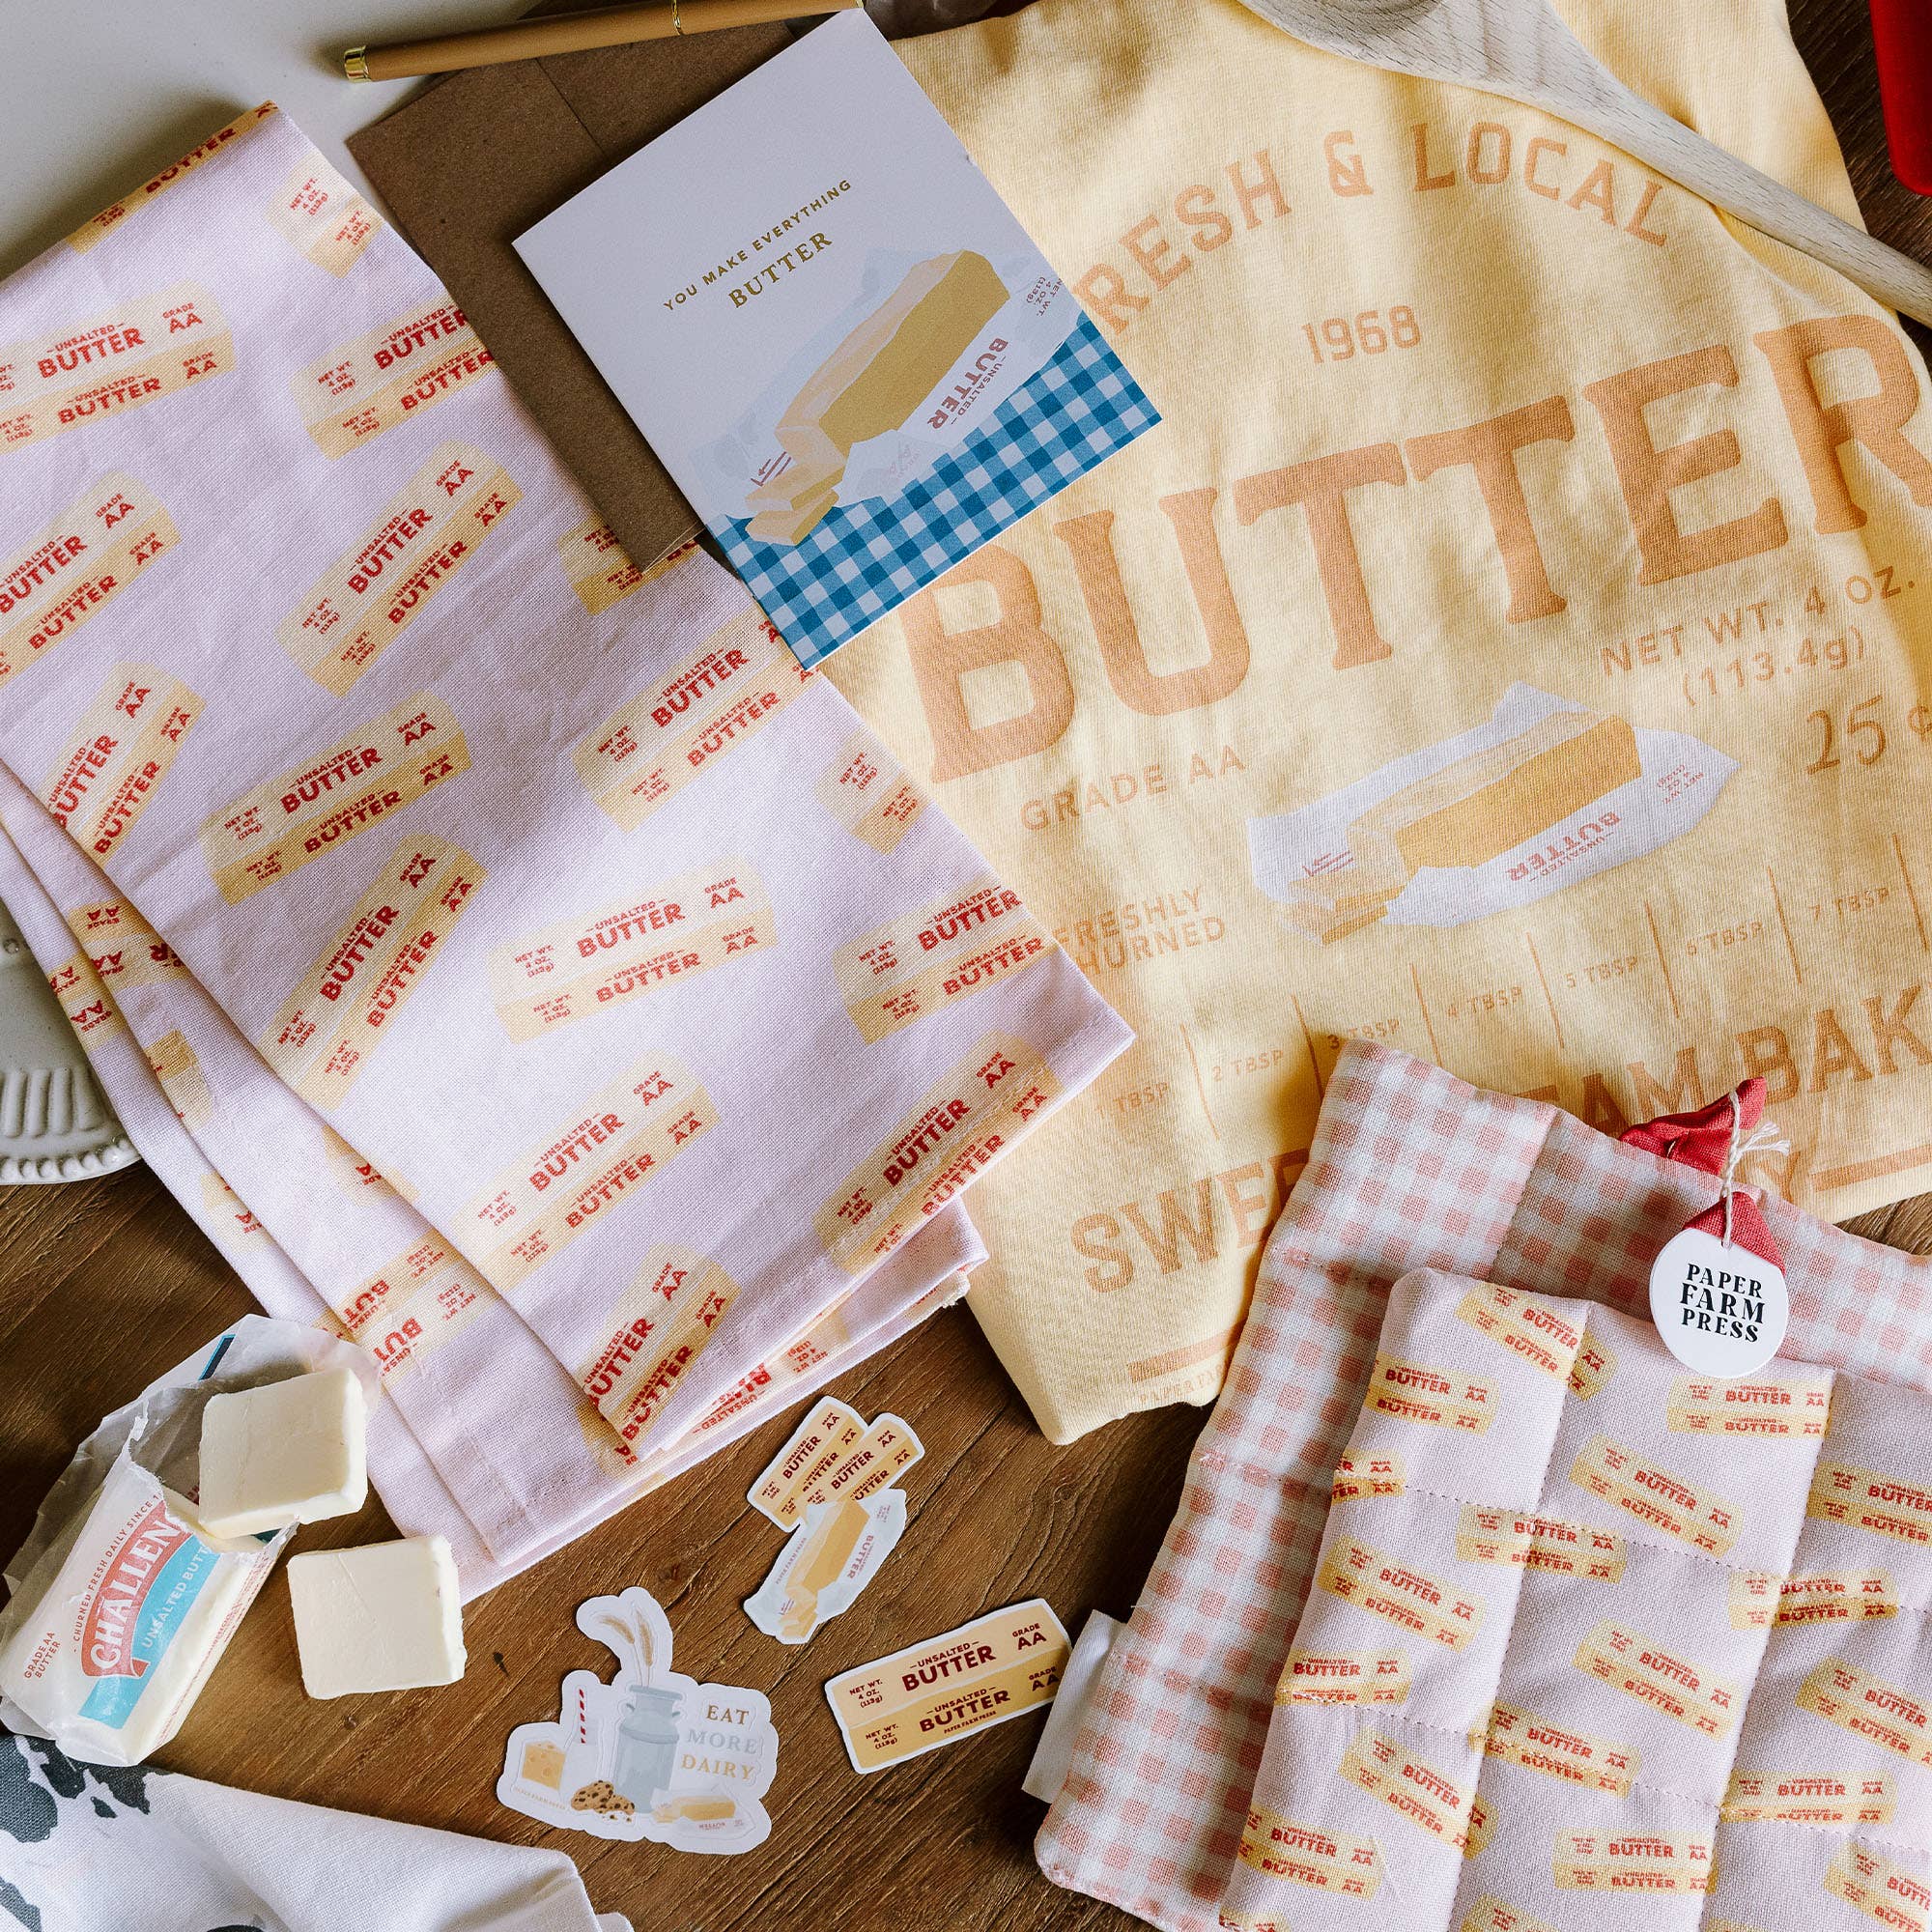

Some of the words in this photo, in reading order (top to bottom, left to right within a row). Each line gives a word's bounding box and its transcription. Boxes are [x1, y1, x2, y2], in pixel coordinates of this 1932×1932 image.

[664, 284, 697, 311] YOU
[702, 249, 748, 285] MAKE
[753, 180, 851, 251] EVERYTHING
[1075, 151, 1293, 335] RESH
[1324, 130, 1375, 197] &
[1412, 123, 1667, 246] LOCAL
[728, 231, 832, 307] BUTTER
[163, 303, 193, 319] GRADE
[169, 313, 203, 334] AA
[39, 327, 145, 378] BUTTER
[55, 324, 116, 351] UNSALTED
[374, 312, 467, 370] BUTTER
[1302, 305, 1422, 363] 1968
[186, 359, 216, 379] AA
[400, 352, 494, 412] BUTTER
[927, 337, 1009, 429] BUTTER
[58, 378, 161, 424] BUTTER
[958, 363, 1003, 415] UNSALTED
[445, 468, 474, 497] AA
[103, 501, 134, 528] AA
[348, 508, 433, 594] BUTTER
[355, 517, 402, 564] UNSALTED
[904, 313, 1932, 783] BUTTER
[0, 536, 88, 613] BUTTER
[388, 541, 468, 624] BUTTER
[29, 575, 118, 649] BUTTER
[1600, 626, 1684, 676] NET
[1704, 601, 1784, 644] WT.
[1804, 586, 1826, 615] 4
[1846, 566, 1915, 604] OZ.
[1683, 626, 1863, 706] (113.4g)
[125, 686, 151, 718] AA
[651, 649, 750, 726] BUTTER
[398, 713, 427, 733] GRADE
[405, 722, 436, 745] AA
[688, 692, 781, 766] BUTTER
[1806, 695, 1886, 774] 25
[281, 748, 383, 813] BUTTER
[297, 751, 353, 785] UNSALTED
[94, 760, 161, 853] BUTTER
[1021, 765, 1167, 831] GRADE
[1189, 746, 1246, 784] AA
[304, 791, 401, 854] BUTTER
[1505, 811, 1620, 881] BUTTER
[595, 901, 656, 930] UNSALTED
[711, 887, 746, 908] AA
[1835, 888, 1889, 915] TBSP
[578, 903, 686, 957] BUTTER
[918, 889, 1023, 952] BUTTER
[1052, 888, 1200, 947] FRESHLY
[1710, 922, 1764, 951] TBSP
[320, 905, 399, 1001] BUTTER
[1076, 917, 1225, 974] HURNED
[367, 930, 439, 1027] BUTTER
[596, 952, 700, 1003] BUTTER
[943, 937, 1045, 995] BUTTER
[1584, 955, 1639, 984] TBSP
[1469, 986, 1523, 1014] TBSP
[1231, 1049, 1283, 1074] TBSP
[1327, 1035, 1339, 1049] 3
[634, 1071, 661, 1095] GRADE
[641, 1079, 673, 1106] AA
[1115, 1082, 1168, 1112] TBSP
[529, 1112, 624, 1191] BUTTER
[540, 1120, 592, 1161] UNSALTED
[884, 1099, 971, 1186] BUTTER
[566, 1153, 655, 1228] BUTTER
[922, 1134, 1004, 1216] BUTTER
[1687, 1264, 1762, 1298] PAPER
[1680, 1283, 1765, 1324] FARM
[1522, 1309, 1578, 1350] BUTTER
[1682, 1307, 1759, 1343] PRESS
[622, 1345, 695, 1439] BUTTER
[1385, 1369, 1450, 1395] BUTTER
[1725, 1390, 1791, 1406] BUTTER
[826, 1414, 839, 1430] AA
[844, 1431, 856, 1445] AA
[881, 1434, 895, 1447] AA
[782, 1435, 821, 1479] BUTTER
[785, 1439, 807, 1463] UNSALTED
[806, 1457, 827, 1481] UNSALTED
[831, 1451, 874, 1490] BUTTER
[836, 1453, 860, 1476] UNSALTED
[896, 1452, 910, 1465] AA
[853, 1469, 889, 1501] UTTER
[1634, 1470, 1696, 1511] BUTTER
[1514, 1520, 1577, 1544] BUTTER
[1621, 1497, 1681, 1534] BUTTER
[73, 1594, 91, 1641] CHURNED
[88, 1560, 107, 1590] FRESH
[105, 1530, 127, 1557] DAILY
[128, 1501, 153, 1527] SINCE
[847, 1535, 873, 1579] BUTTER
[142, 1582, 186, 1648] UNSALTED
[1012, 1623, 1040, 1637] GRADE
[24, 1646, 45, 1679] GRADE
[44, 1631, 55, 1646] AA
[35, 1640, 61, 1679] BUTTER
[918, 1643, 970, 1667] UNSALTED
[1017, 1632, 1046, 1650] AA
[849, 1686, 867, 1695] NET
[867, 1679, 883, 1689] WT.
[902, 1645, 996, 1691] BUTTER
[1029, 1666, 1056, 1680] GRADE
[1032, 1674, 1059, 1691] AA
[1293, 1663, 1360, 1677] BUTTER
[1639, 1652, 1701, 1691] BUTTER
[706, 1705, 750, 1725] EAT
[860, 1695, 883, 1708] (113g)
[920, 1690, 1010, 1732] BUTTER
[935, 1689, 987, 1713] UNSALTED
[1865, 1690, 1927, 1727] BUTTER
[688, 1729, 757, 1753] MORE
[866, 1730, 882, 1740] NET
[682, 1754, 754, 1779] DAIRY
[1402, 1764, 1460, 1809] BUTTER
[1777, 1784, 1845, 1796] BUTTER
[1271, 1829, 1337, 1858] BUTTER
[1609, 1842, 1674, 1858] BUTTER
